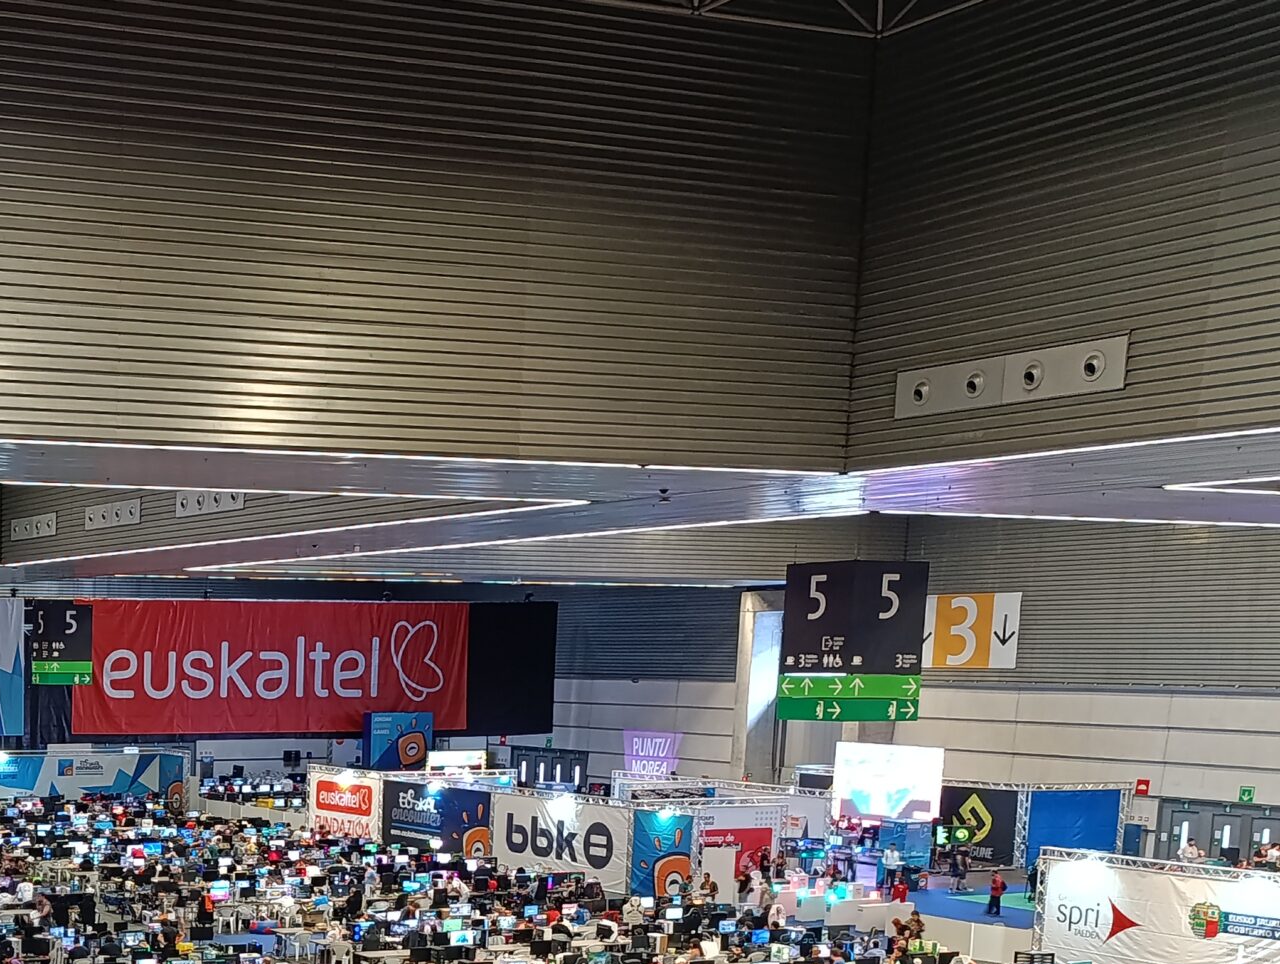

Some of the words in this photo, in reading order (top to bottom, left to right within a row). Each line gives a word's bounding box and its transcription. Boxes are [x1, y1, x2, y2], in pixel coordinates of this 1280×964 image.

[807, 574, 827, 620] 5
[878, 573, 901, 620] 5
[37, 610, 44, 634] 5
[65, 610, 77, 634] 5
[945, 596, 978, 666] 3
[103, 636, 379, 699] euskaltel
[798, 653, 805, 668] 3
[895, 654, 902, 668] 3
[632, 737, 671, 757] PUNTU
[320, 790, 360, 808] euskaltel
[506, 812, 578, 863] bbk
[1056, 903, 1100, 931] spri
